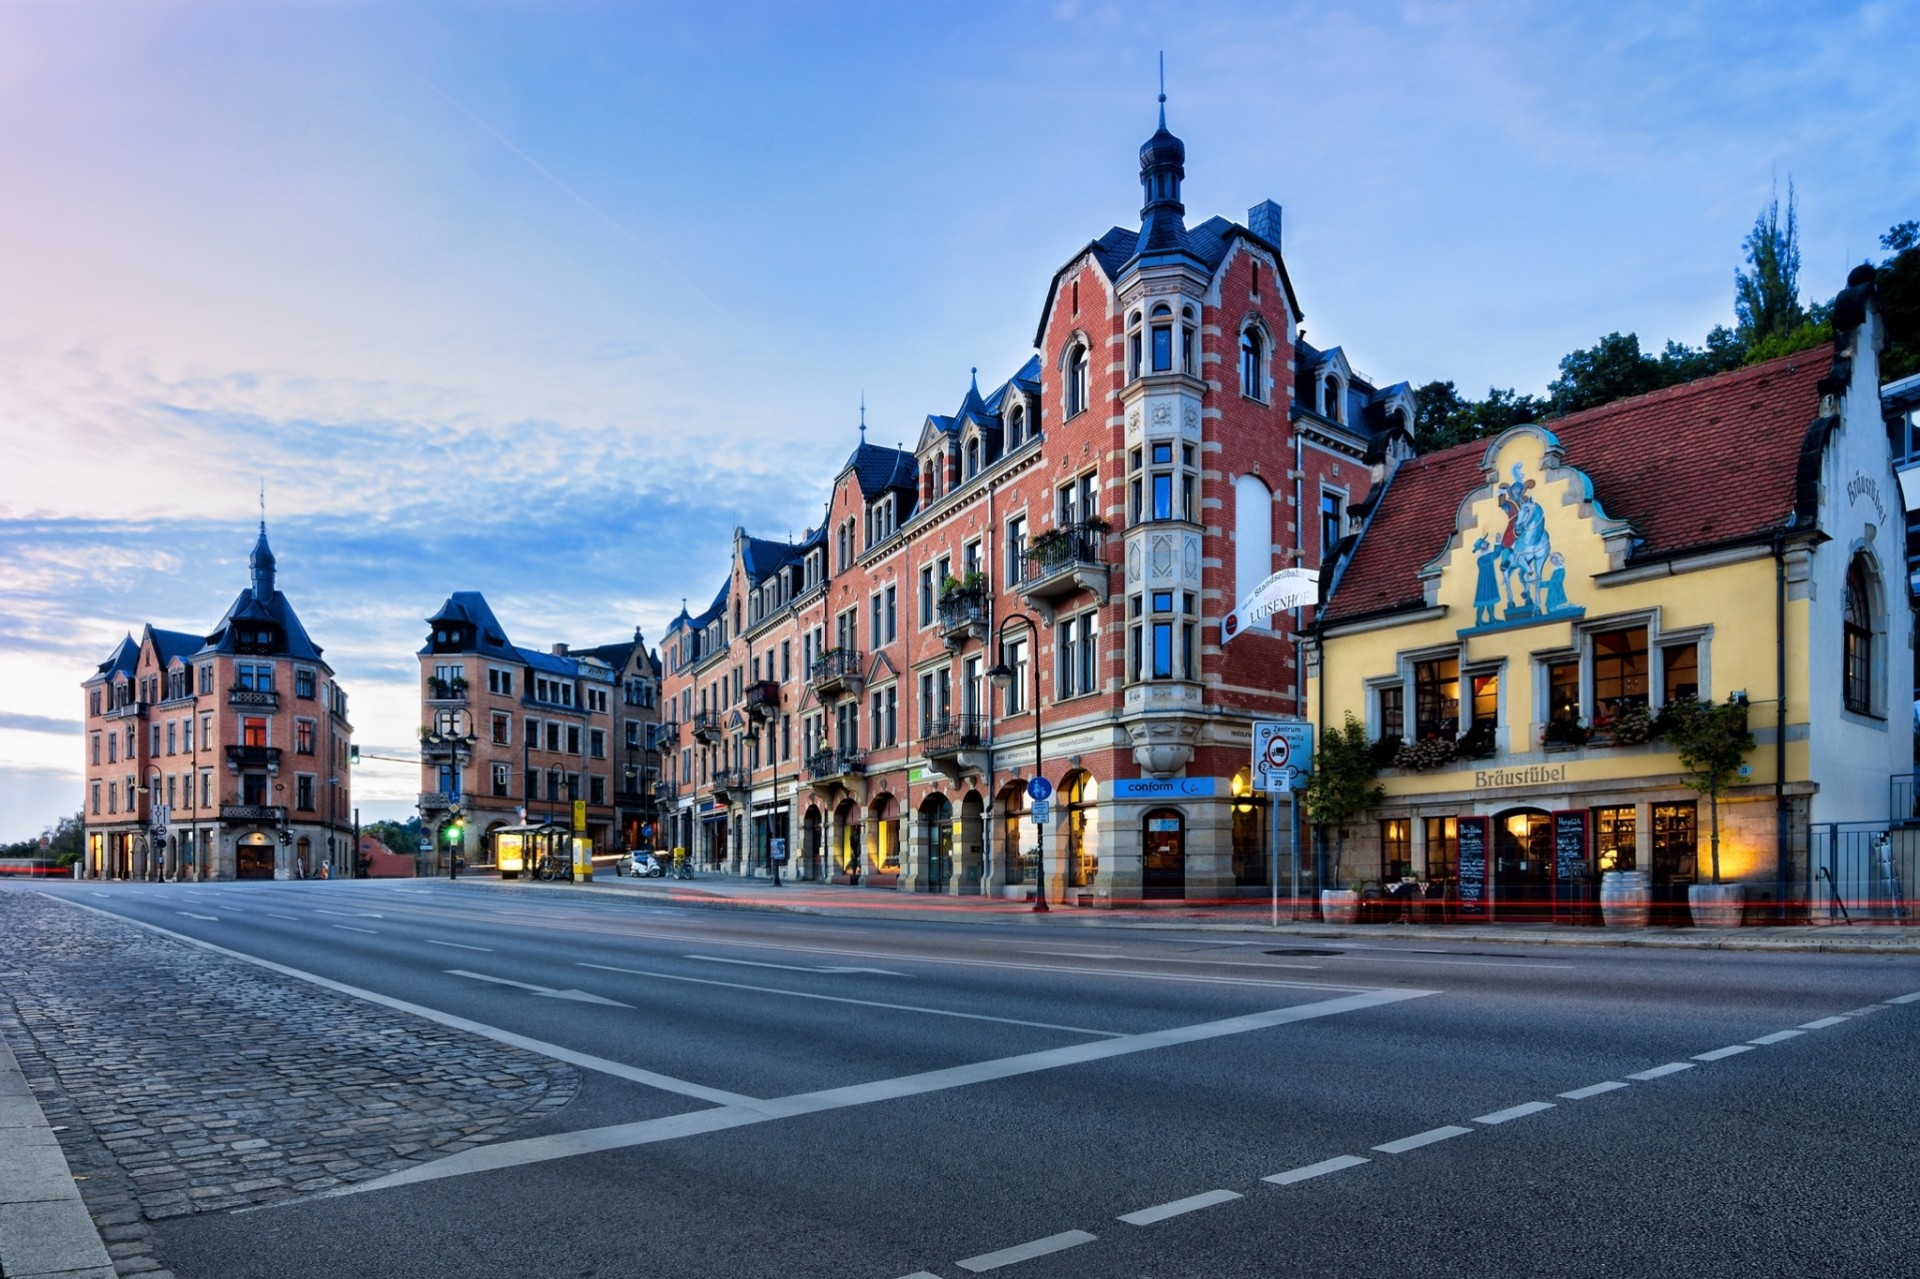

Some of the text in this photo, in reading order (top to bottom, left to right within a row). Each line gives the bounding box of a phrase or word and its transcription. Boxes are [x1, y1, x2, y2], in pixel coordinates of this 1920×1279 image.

[1250, 591, 1310, 624] LUISENHOF
[1231, 730, 1252, 738] restaurie
[1273, 725, 1301, 733] Zentrum
[1475, 764, 1566, 788] Bräustübel
[1128, 782, 1173, 793] conform
